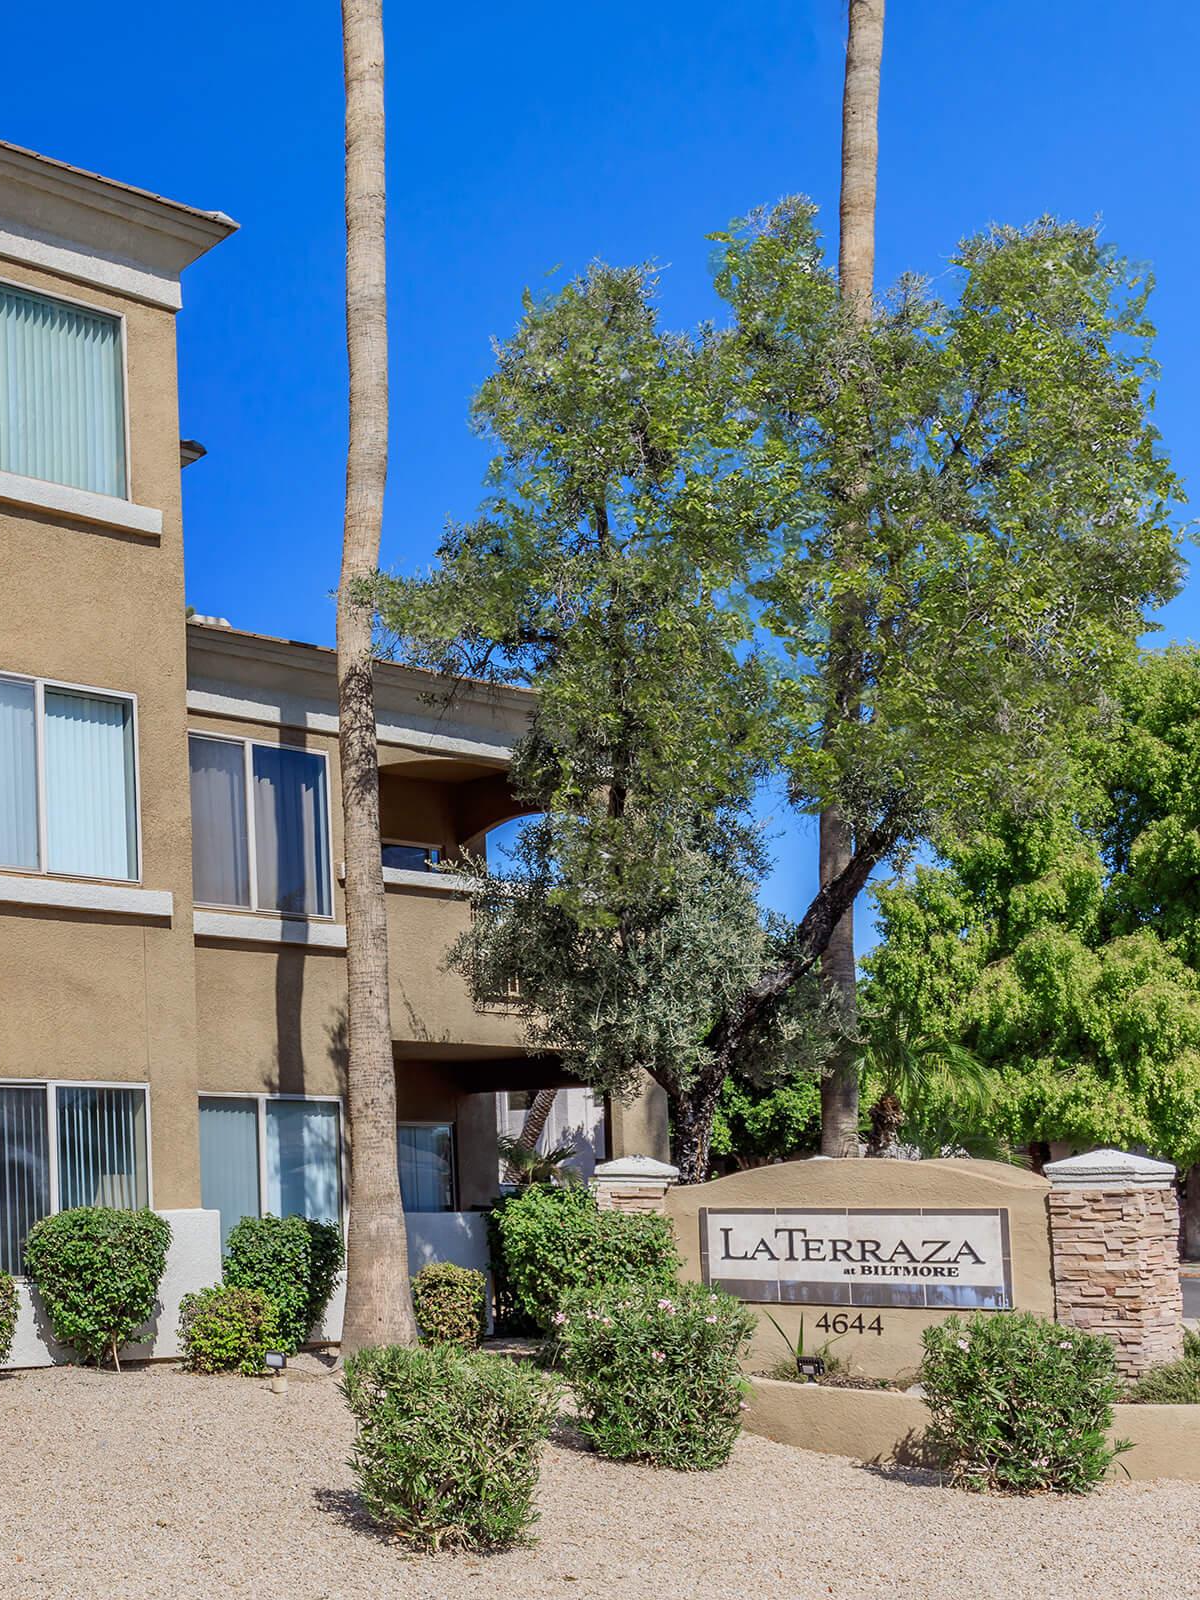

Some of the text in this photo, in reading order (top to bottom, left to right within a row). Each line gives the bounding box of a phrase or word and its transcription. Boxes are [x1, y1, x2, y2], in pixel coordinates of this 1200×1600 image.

[843, 1265, 960, 1278] at BILTMORE
[815, 1312, 884, 1336] 4644
